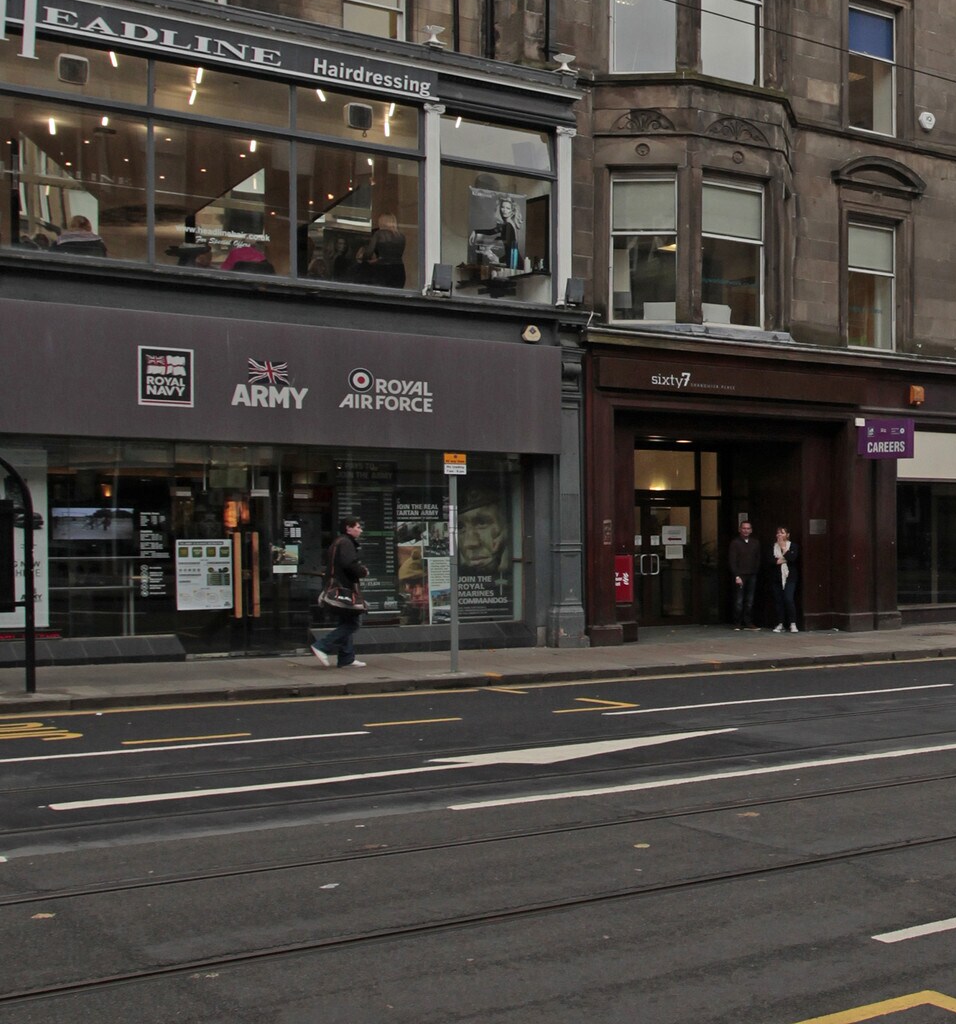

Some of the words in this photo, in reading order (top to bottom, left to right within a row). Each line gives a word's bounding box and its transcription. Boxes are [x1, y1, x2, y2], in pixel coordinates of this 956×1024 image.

[313, 57, 431, 97] Hairdressing
[196, 235, 208, 244] For
[208, 237, 232, 246] Special
[232, 240, 252, 248] Offers
[146, 376, 186, 387] ROYAL
[375, 378, 433, 396] ROYAL
[146, 386, 186, 397] NAVY
[231, 383, 309, 409] ARMY
[338, 393, 374, 410] AIR
[375, 395, 433, 413] FORCE
[867, 441, 906, 454] CAREERS
[457, 597, 508, 605] COMMANDOS
